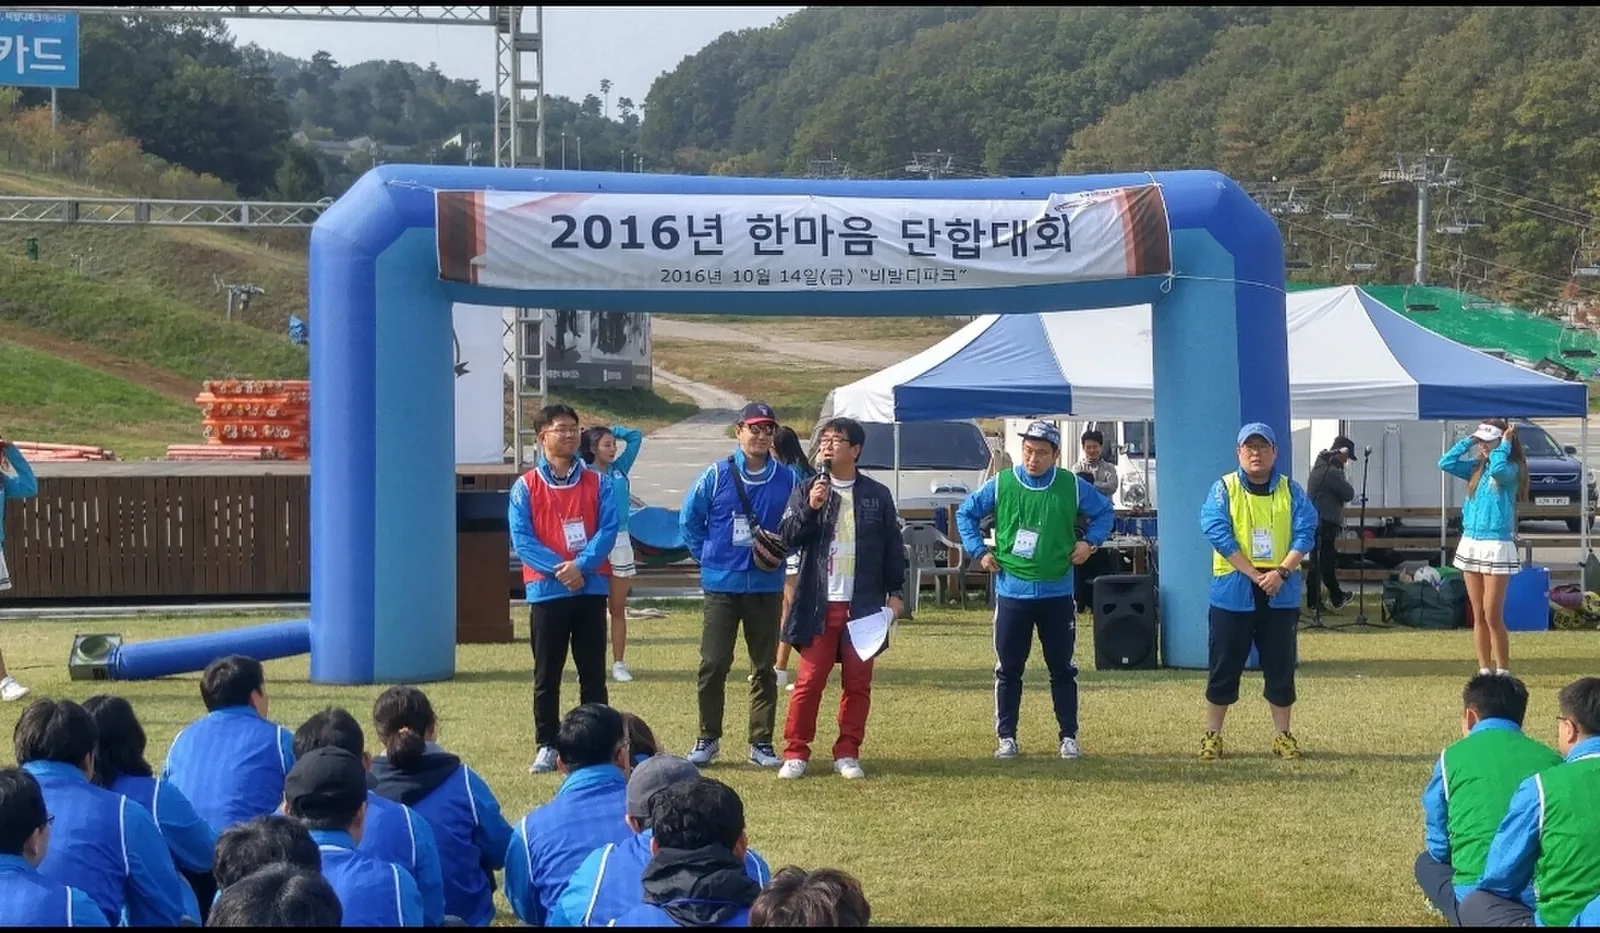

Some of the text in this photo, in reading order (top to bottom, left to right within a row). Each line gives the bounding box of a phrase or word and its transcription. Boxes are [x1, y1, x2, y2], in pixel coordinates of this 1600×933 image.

[551, 213, 1073, 259] 2016년 한마음 단합대회
[660, 269, 722, 285] 2016년
[732, 269, 771, 286] 10월
[780, 268, 853, 286] 14일(금)
